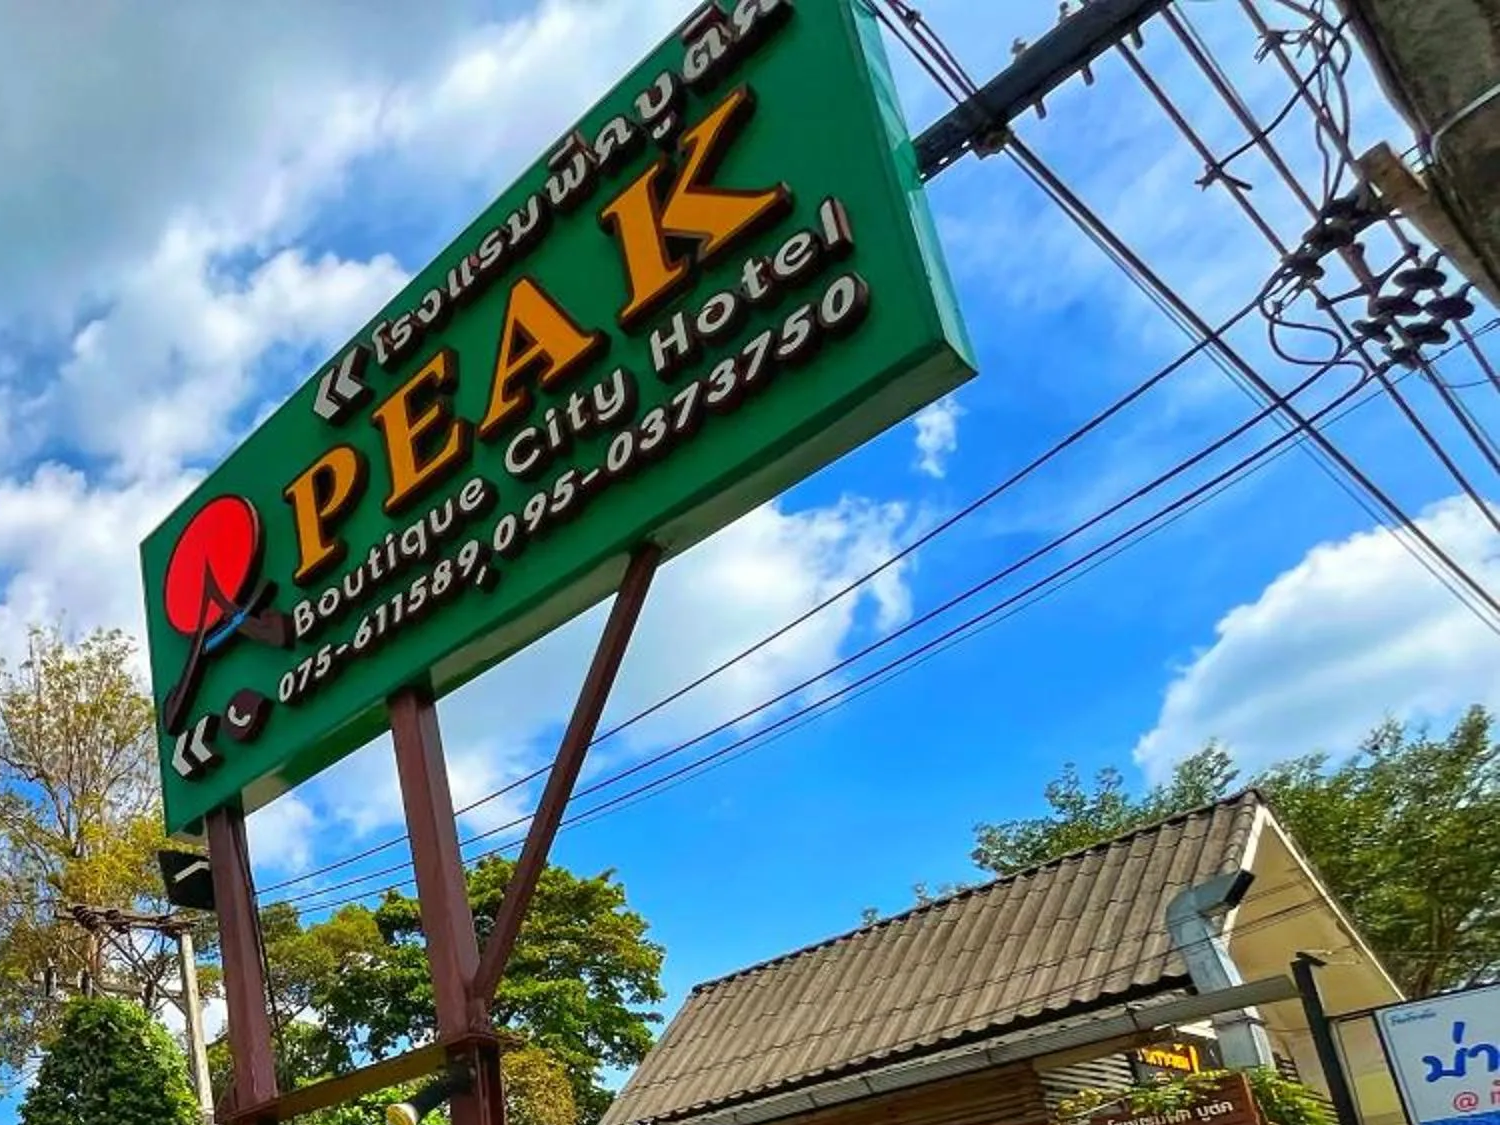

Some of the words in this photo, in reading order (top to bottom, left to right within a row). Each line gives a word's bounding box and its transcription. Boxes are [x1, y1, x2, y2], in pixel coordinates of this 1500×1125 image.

[285, 90, 780, 580] PEAK
[293, 478, 486, 637] Boutique
[505, 368, 625, 474] City
[649, 198, 842, 372] Hotel
